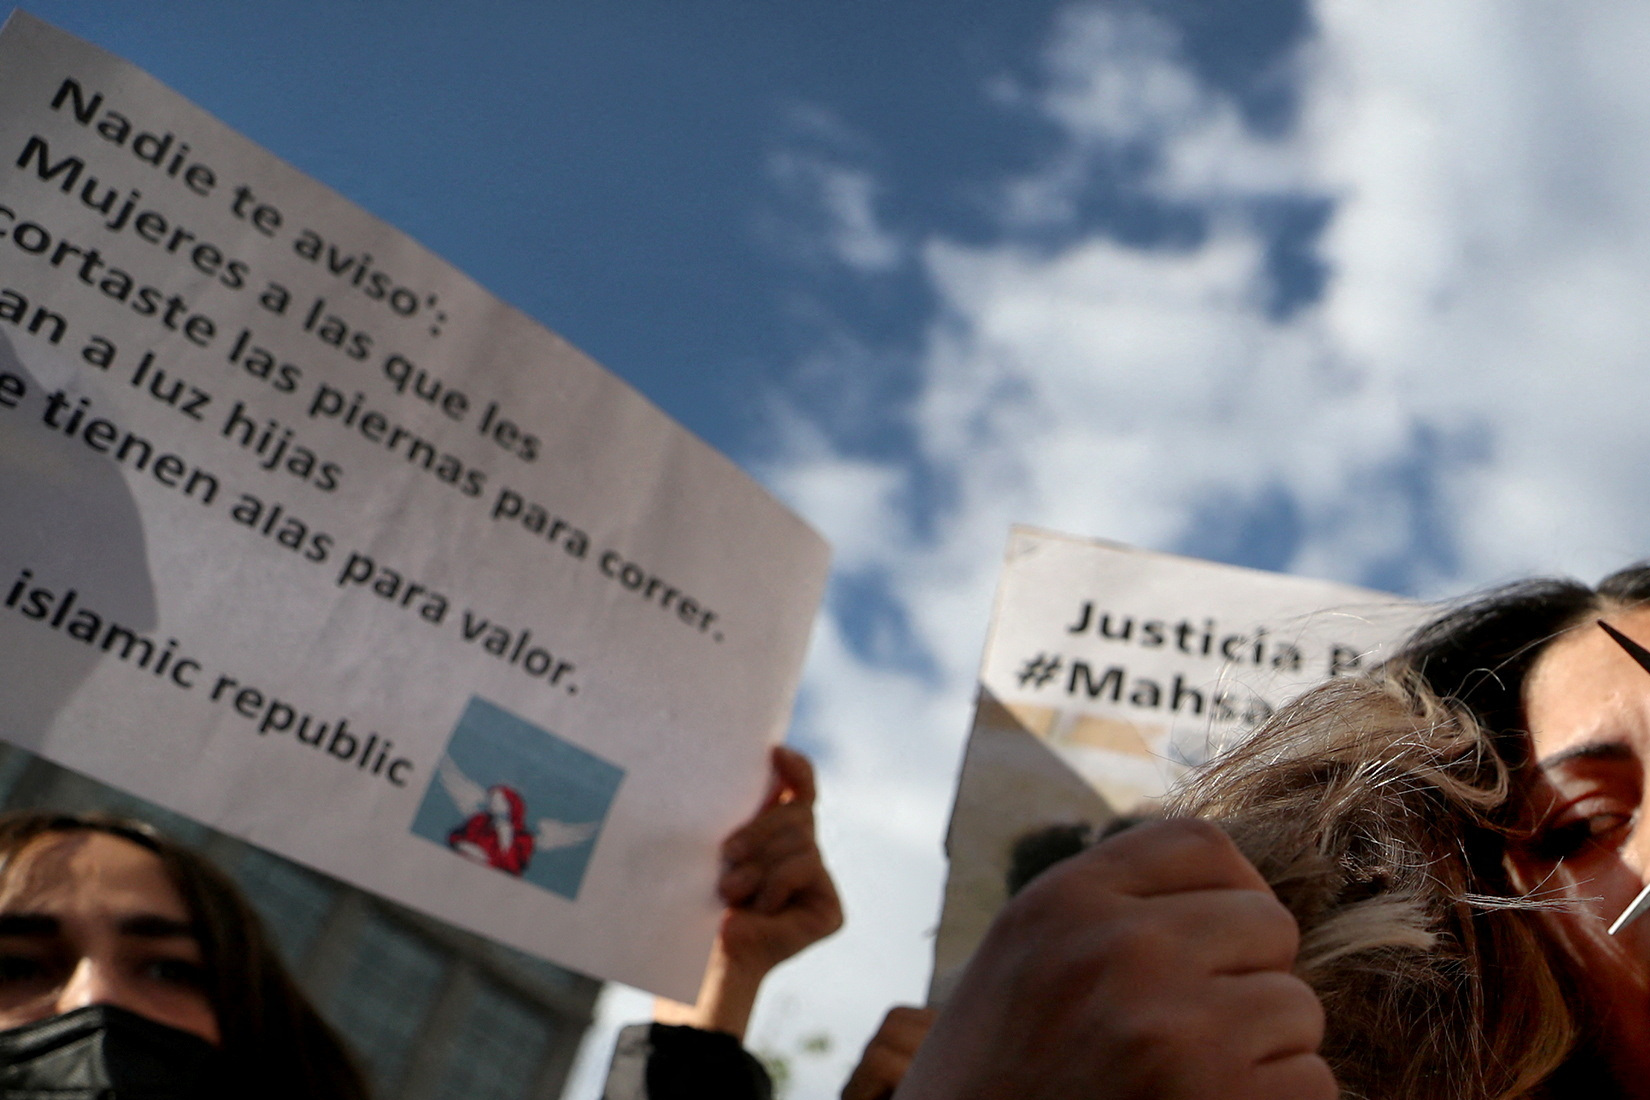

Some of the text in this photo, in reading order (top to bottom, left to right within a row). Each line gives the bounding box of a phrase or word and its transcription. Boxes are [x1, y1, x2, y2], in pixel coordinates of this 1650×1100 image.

[50, 76, 217, 196] Nadie
[232, 184, 284, 237] te
[15, 135, 543, 464] Mujeres a las que les
[82, 335, 117, 371] a
[129, 351, 214, 423] luz
[221, 401, 344, 495] hijas
[228, 328, 303, 395] las
[309, 382, 487, 498] piernas
[491, 487, 591, 561] para
[598, 548, 726, 645] correr.
[41, 387, 220, 505] tienen
[230, 493, 335, 564] alas
[337, 549, 450, 627] para
[461, 606, 580, 697] valor.
[1068, 600, 1302, 672] Justicia
[5, 568, 415, 789] islamic republic
